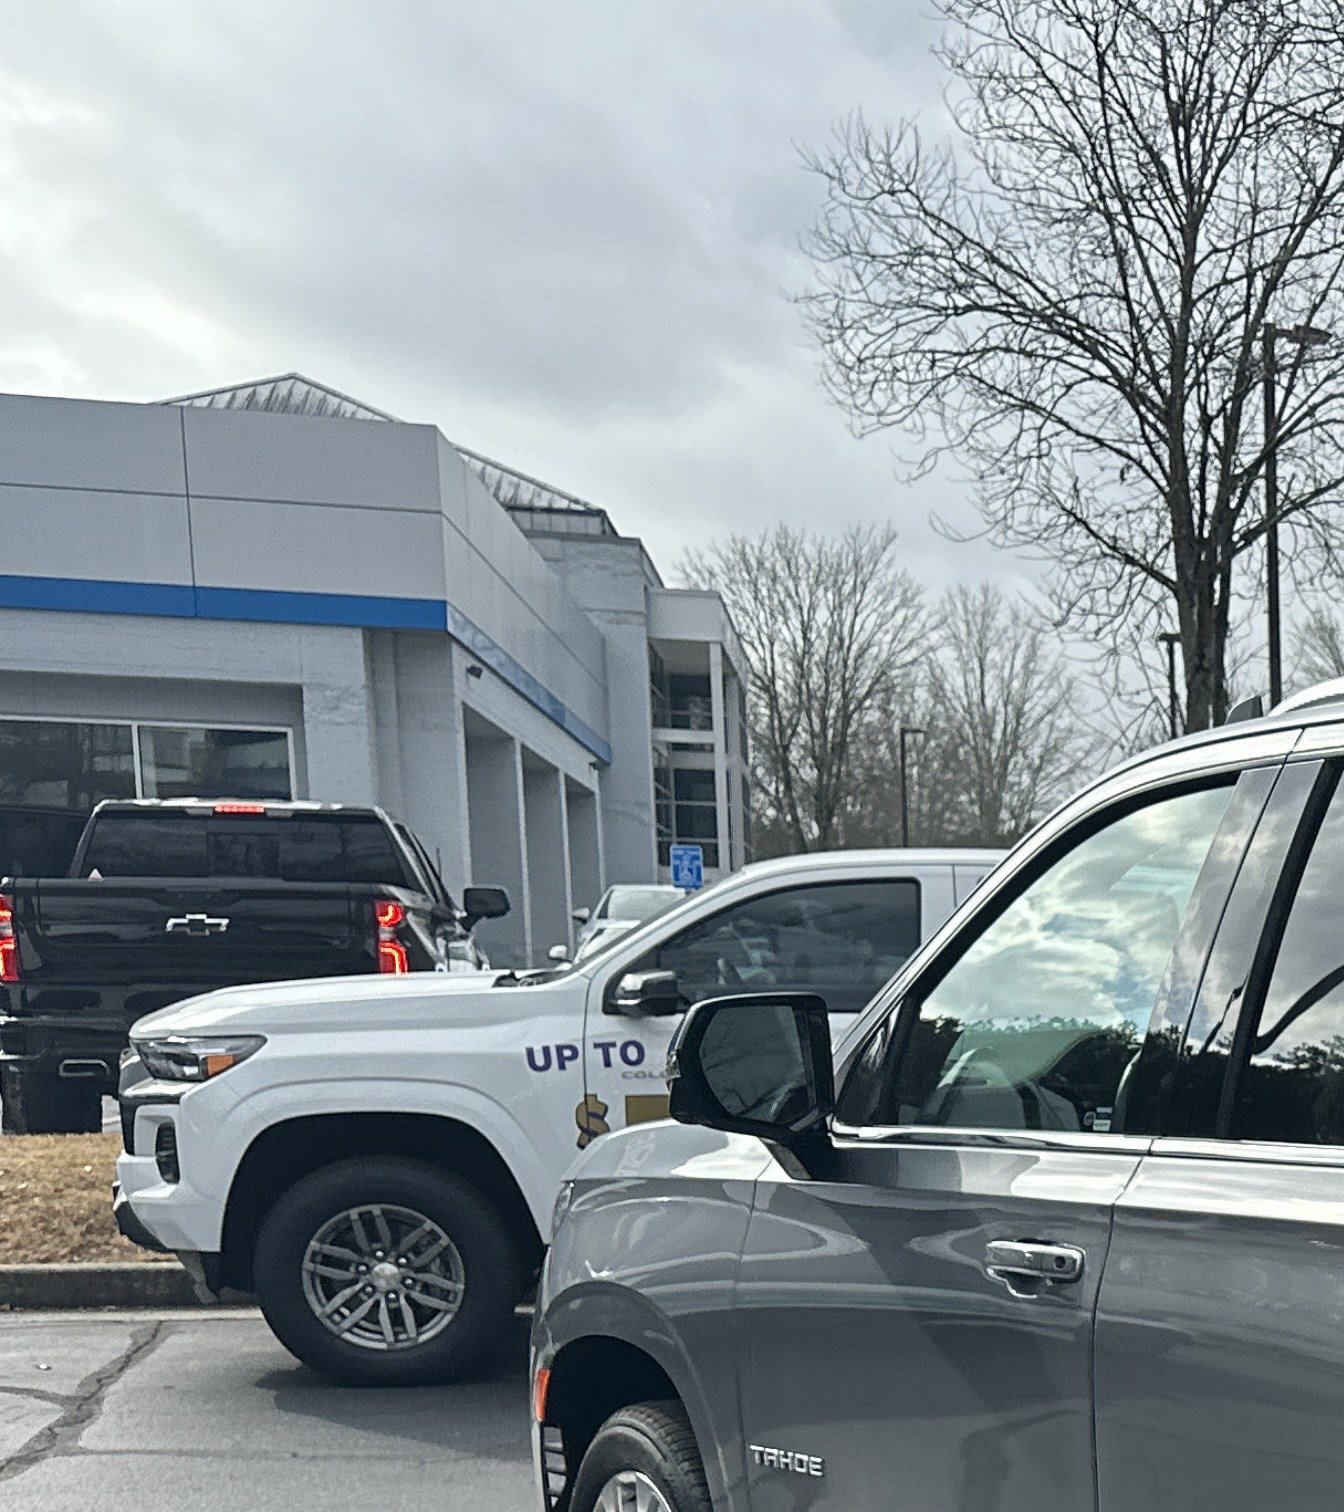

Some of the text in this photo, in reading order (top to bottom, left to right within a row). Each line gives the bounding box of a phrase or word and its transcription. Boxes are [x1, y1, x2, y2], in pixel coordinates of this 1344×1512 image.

[525, 1040, 645, 1072] UP TO
[749, 1444, 824, 1476] TAHOE
